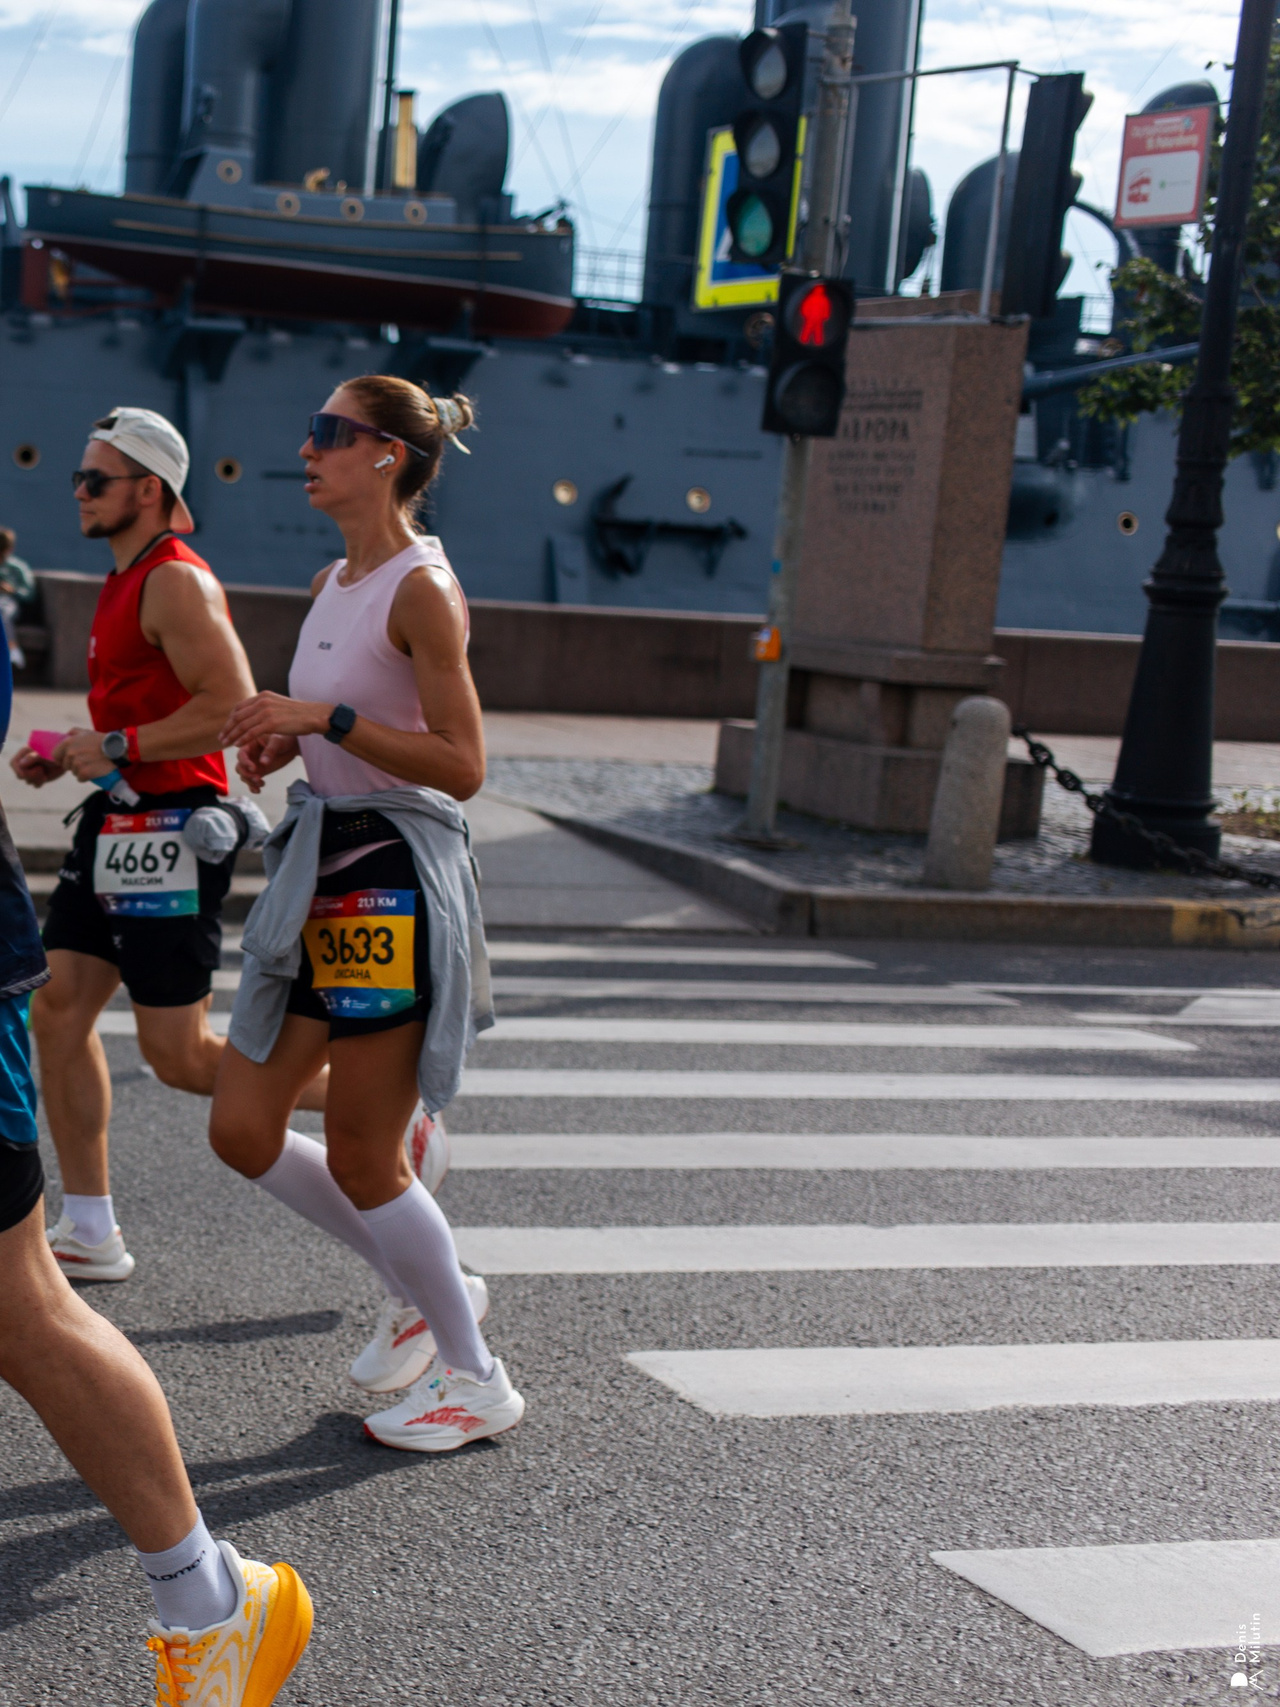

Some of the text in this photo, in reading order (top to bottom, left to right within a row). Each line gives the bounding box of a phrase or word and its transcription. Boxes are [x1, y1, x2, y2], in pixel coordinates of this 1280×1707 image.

[105, 840, 181, 874] 4669
[121, 876, 163, 886] МАКСИМ
[377, 897, 397, 907] КМ
[319, 926, 394, 965] 3633
[334, 969, 371, 979] ОКСАНА
